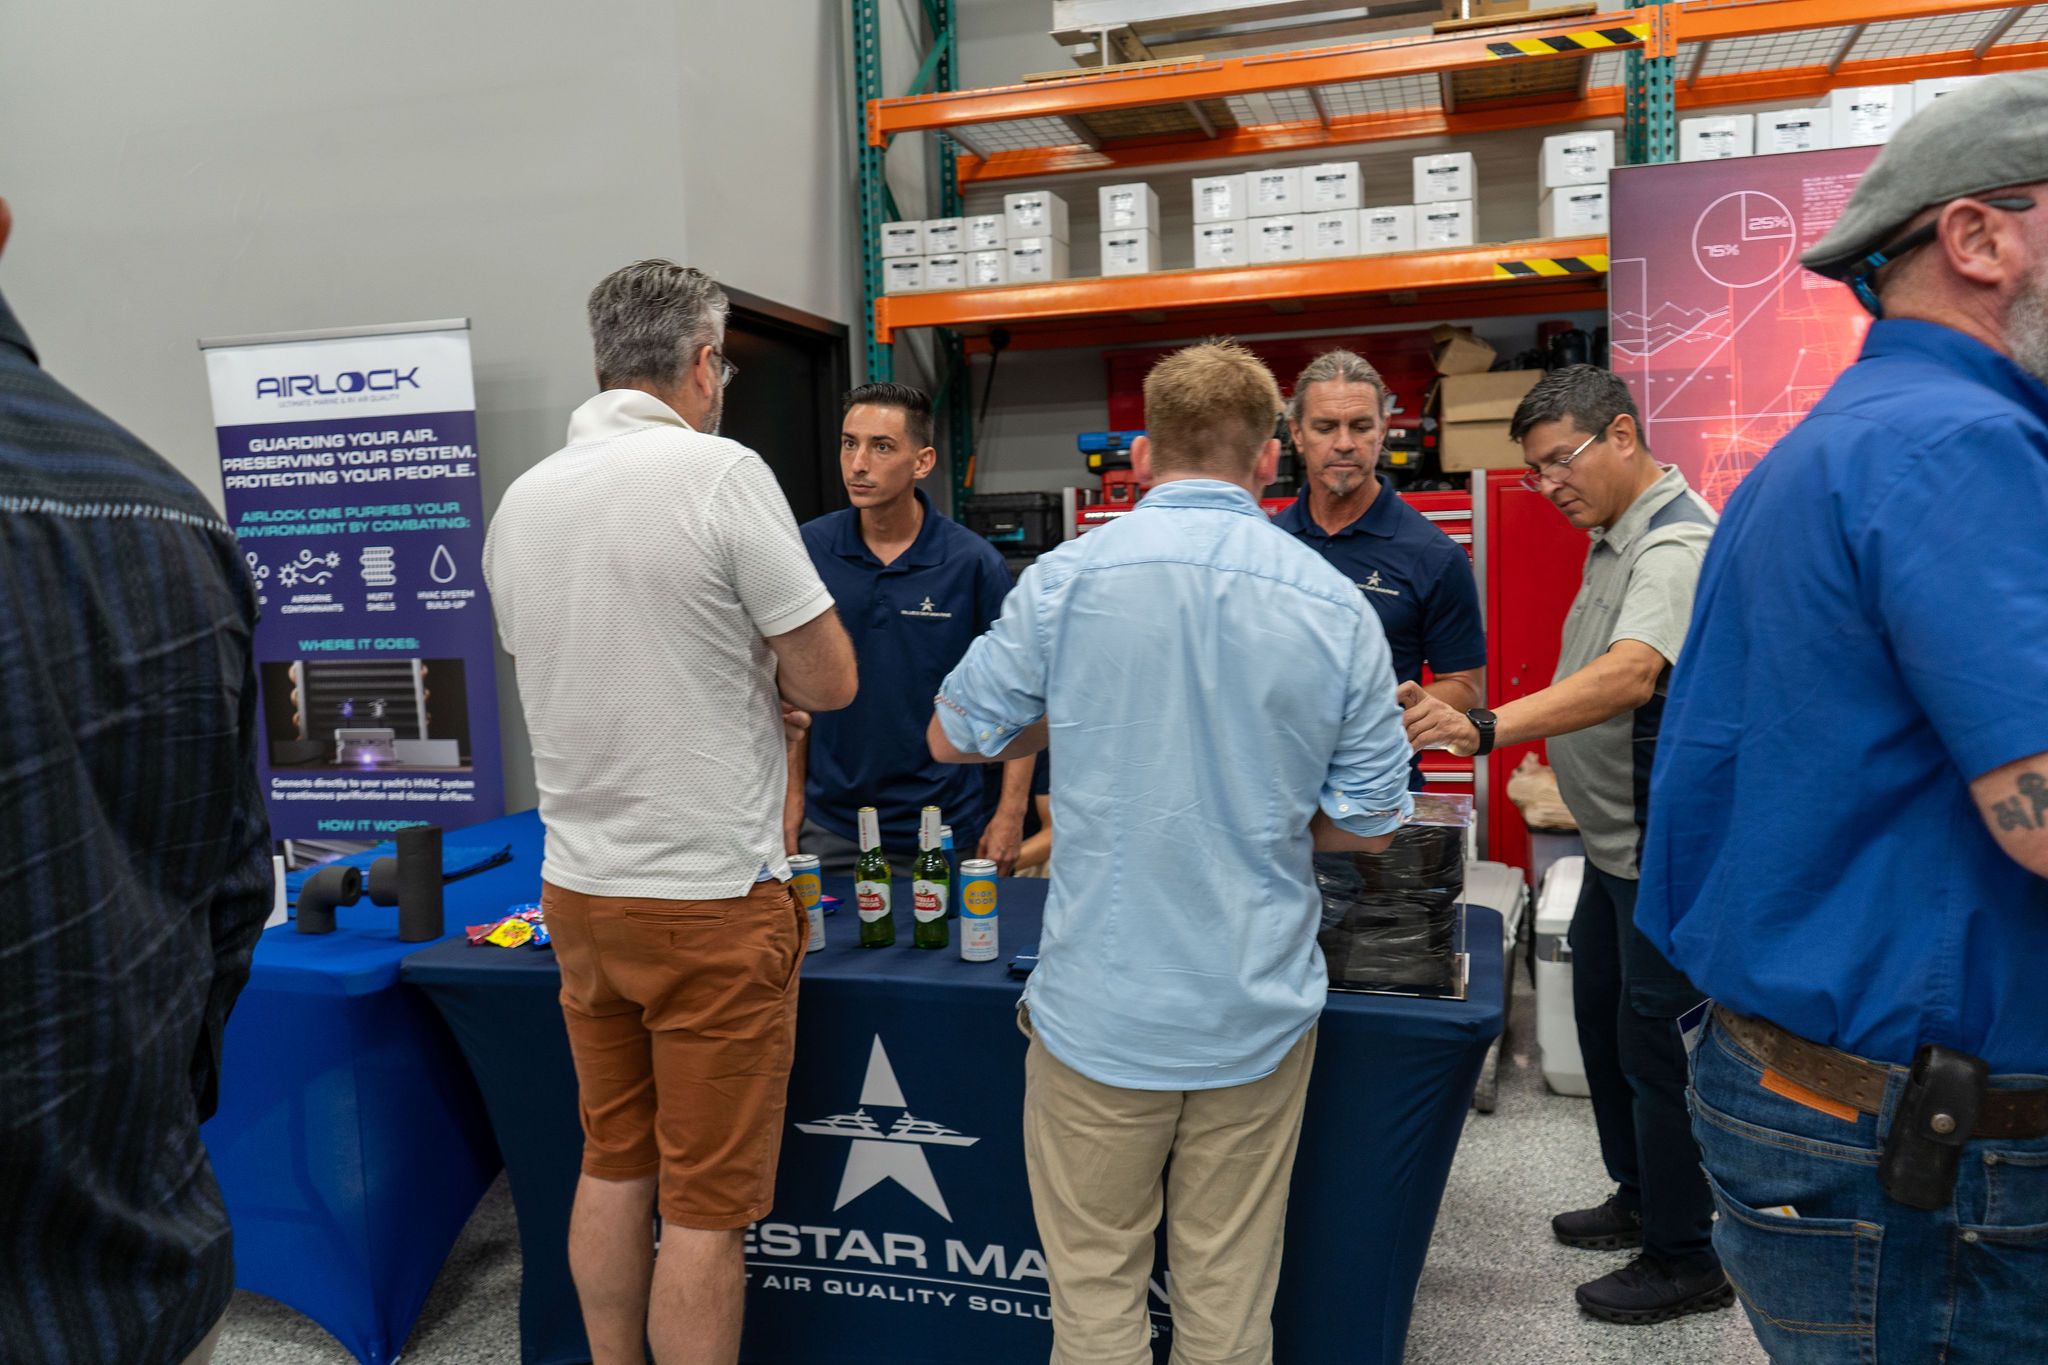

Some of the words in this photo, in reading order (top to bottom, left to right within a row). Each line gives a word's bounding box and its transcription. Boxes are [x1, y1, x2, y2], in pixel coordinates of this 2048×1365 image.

[1748, 215, 1789, 231] 25%
[1702, 244, 1740, 257] 75%
[257, 366, 421, 399] AIRLOCK
[249, 434, 346, 452] GUARDING
[347, 431, 400, 446] YOUR
[401, 428, 438, 443] AIR.
[222, 453, 335, 472] PRESERVING
[336, 449, 388, 465] YOUR
[390, 445, 477, 462] SYSTEM.
[225, 470, 338, 489] PROTECTING
[340, 467, 391, 483] YOUR
[394, 463, 475, 480] PEOPLE.
[241, 509, 306, 523] AIRLOCK
[308, 507, 342, 520] ONE
[344, 504, 412, 518] PURIFIES
[414, 502, 460, 515] YOUR
[235, 522, 347, 538] ENVIRONMENT
[349, 521, 370, 533] BY
[298, 639, 355, 651] WHERE
[357, 638, 371, 650] IT
[314, 777, 348, 790] directly
[361, 779, 380, 790] your
[413, 777, 440, 789] HVAC
[441, 779, 475, 790] system
[271, 790, 285, 801] for
[388, 790, 404, 801] and
[317, 819, 355, 832] HOW
[357, 819, 370, 832] IT
[762, 1274, 812, 1292] AIR
[822, 1279, 956, 1306] QUALITY
[968, 1296, 1052, 1320] SOLU
